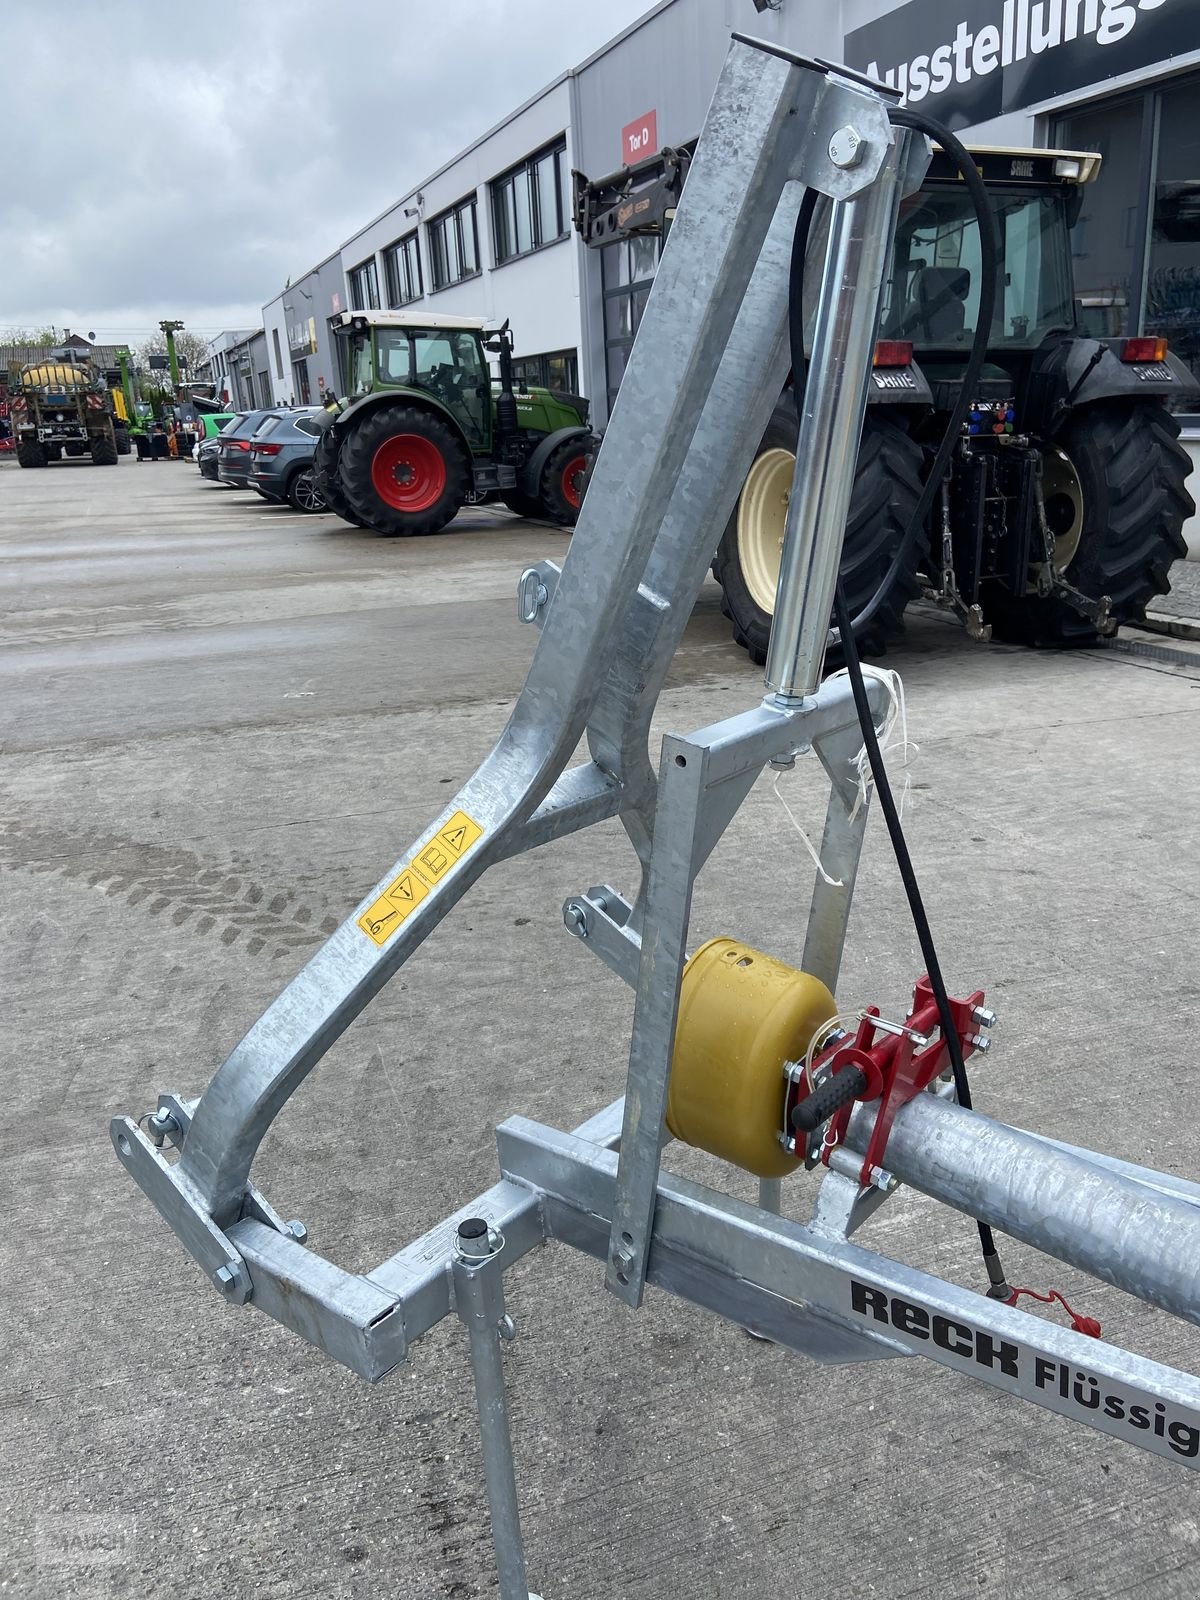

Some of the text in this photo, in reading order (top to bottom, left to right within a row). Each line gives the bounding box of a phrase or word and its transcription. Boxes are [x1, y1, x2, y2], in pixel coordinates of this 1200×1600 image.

[866, 0, 1166, 107] usstellung
[629, 127, 649, 153] Tor D
[1035, 1356, 1200, 1458] Flüssig
